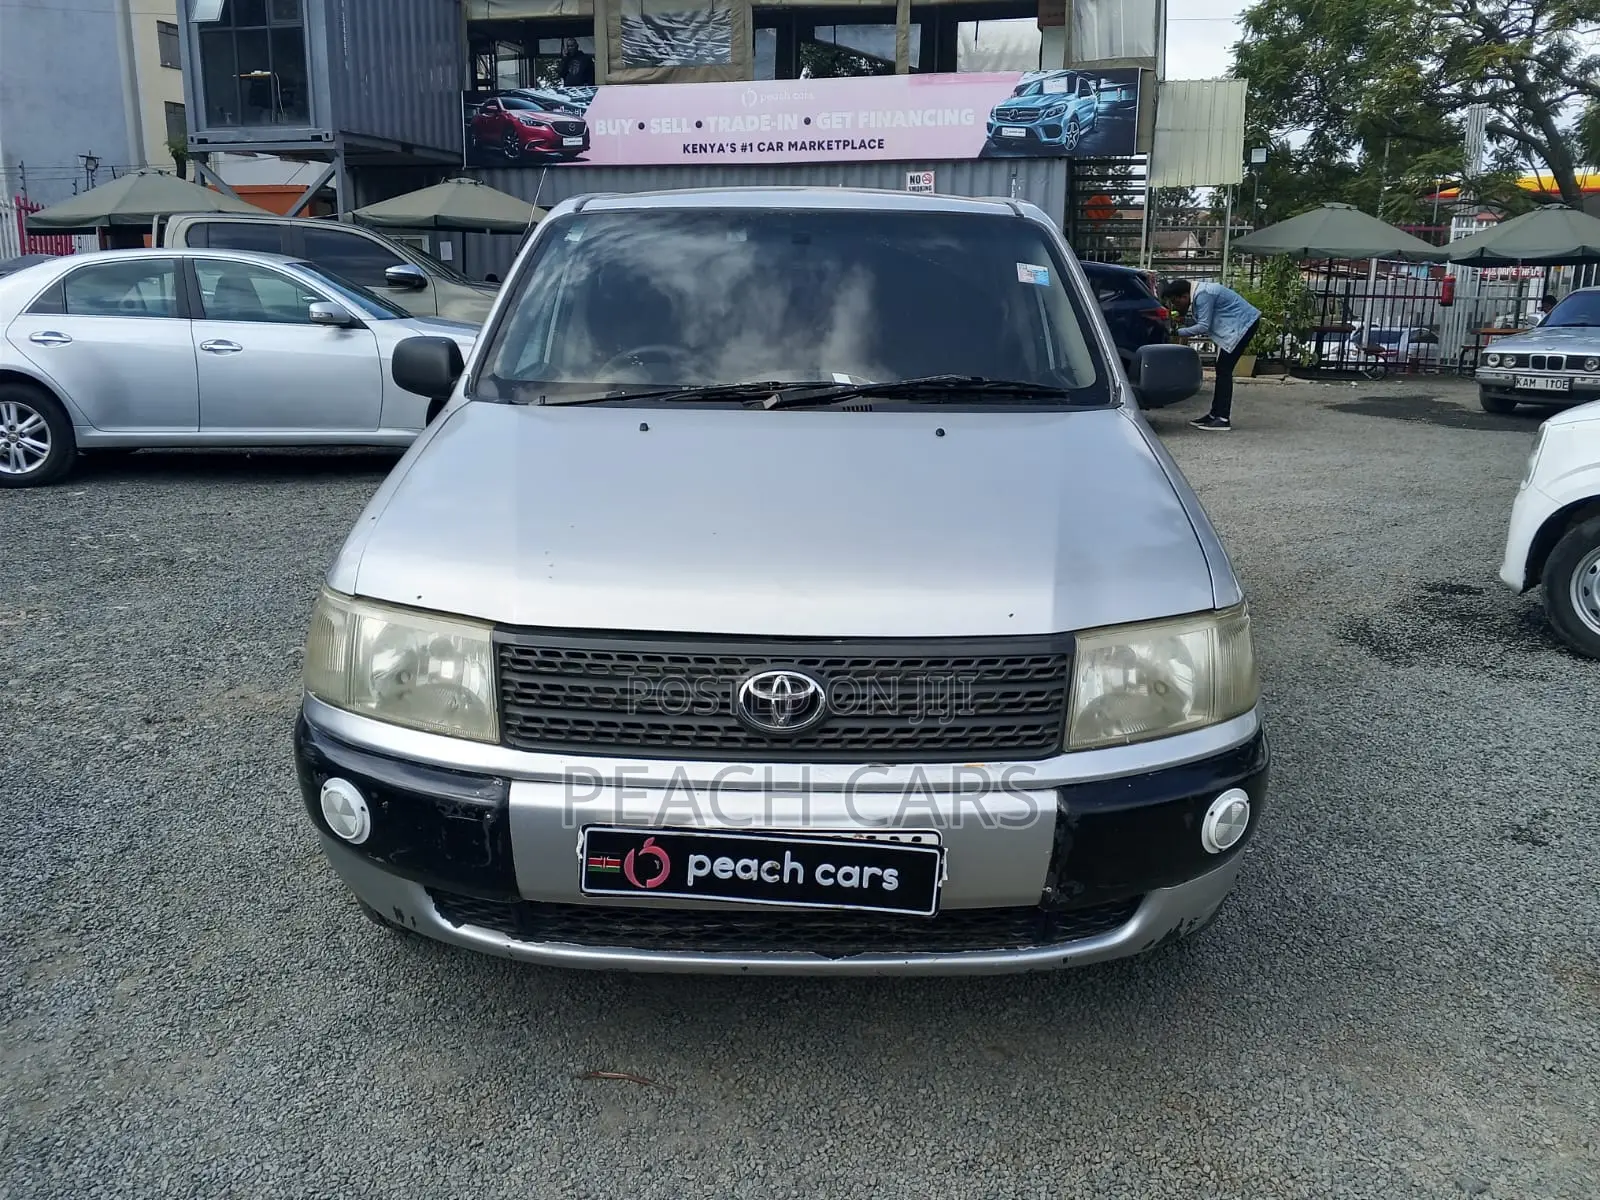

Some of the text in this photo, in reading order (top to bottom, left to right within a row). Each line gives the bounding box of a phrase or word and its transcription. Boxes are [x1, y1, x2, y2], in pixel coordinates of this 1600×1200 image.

[595, 108, 975, 136] BUY SELL TRADE-IN GET FINANCING
[682, 138, 885, 154] KENYA'S #1 CAR MARKETPLACE
[909, 174, 921, 184] NO
[1515, 378, 1537, 388] KAM
[687, 850, 899, 891] peach cars
